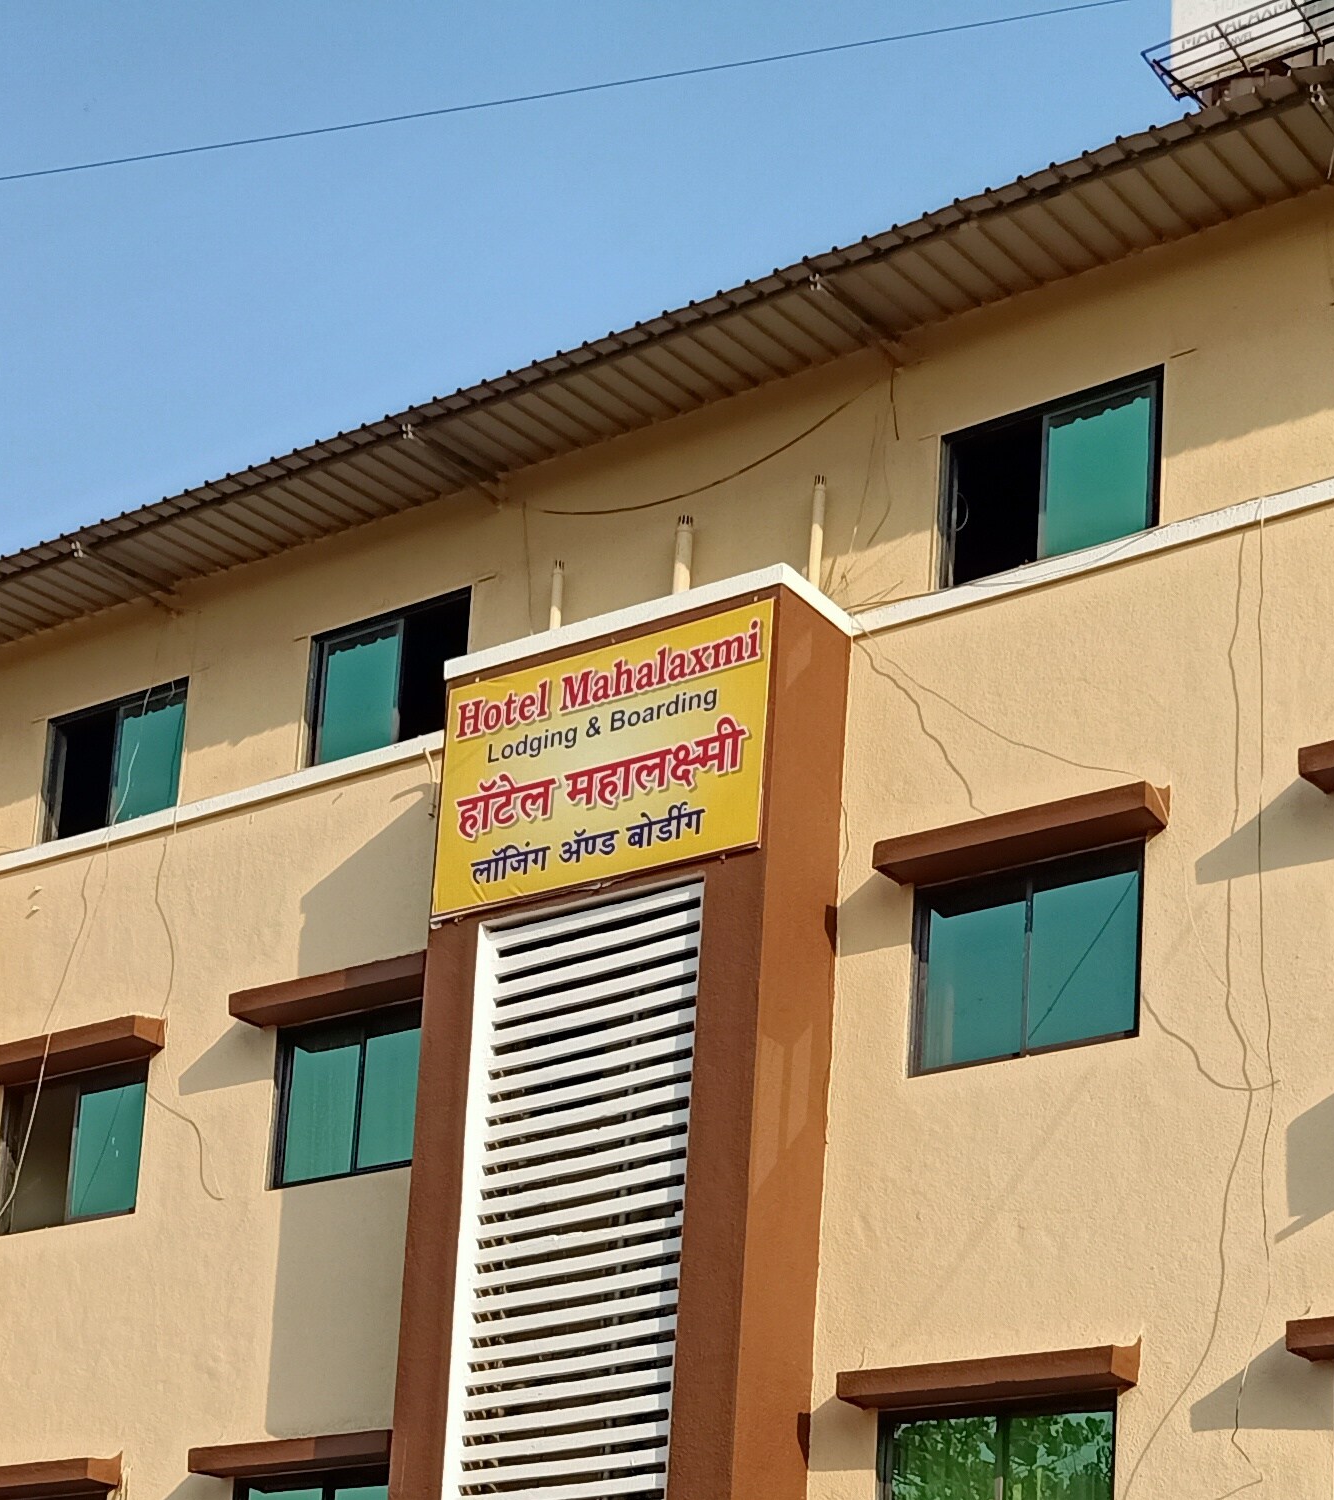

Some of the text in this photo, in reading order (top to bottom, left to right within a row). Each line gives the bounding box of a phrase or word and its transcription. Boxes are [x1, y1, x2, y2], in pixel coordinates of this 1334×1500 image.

[455, 620, 760, 738] Hotel Mahalaxmi
[487, 688, 717, 763] Lodging & Boarding
[456, 717, 747, 838] हॉटेल महालक्ष्मी
